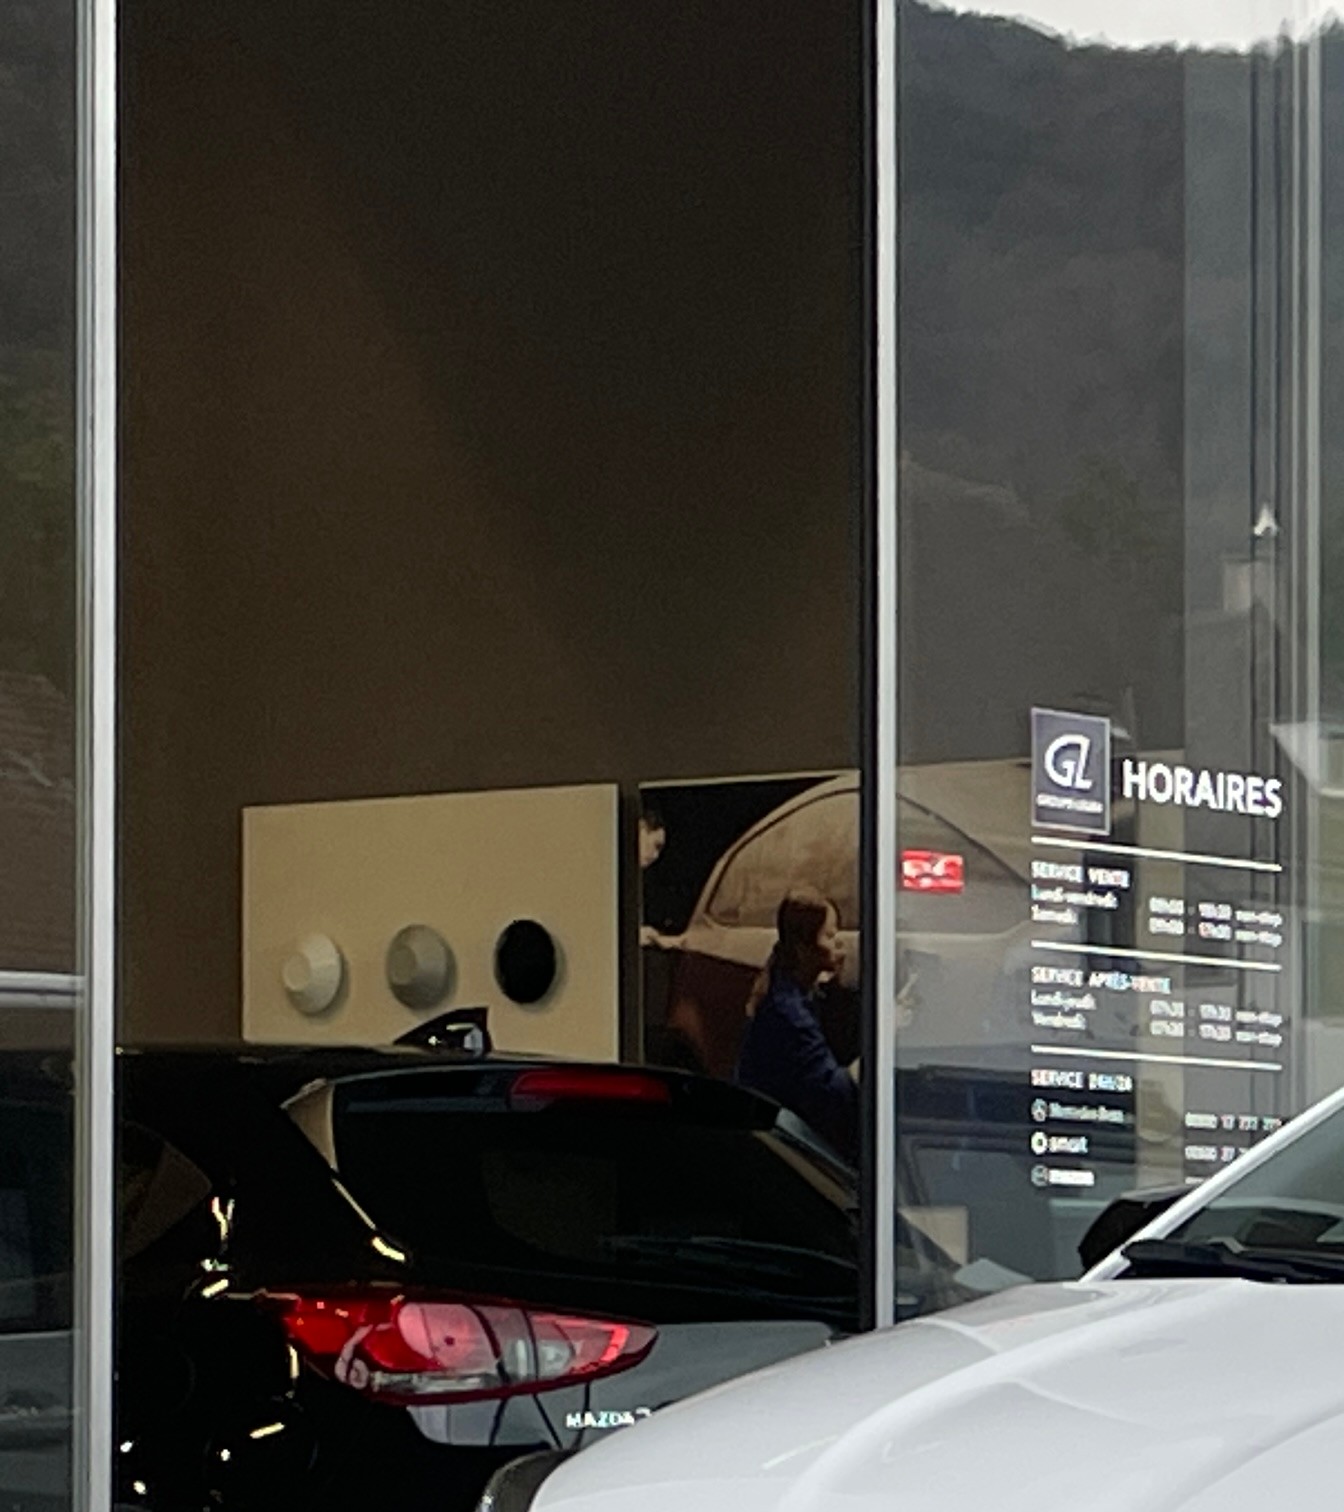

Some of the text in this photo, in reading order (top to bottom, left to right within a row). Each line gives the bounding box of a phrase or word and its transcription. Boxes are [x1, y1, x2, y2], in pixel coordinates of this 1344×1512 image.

[1044, 733, 1093, 790] GL
[1122, 758, 1283, 819] HORAIRES
[1031, 1069, 1084, 1090] SERVICE
